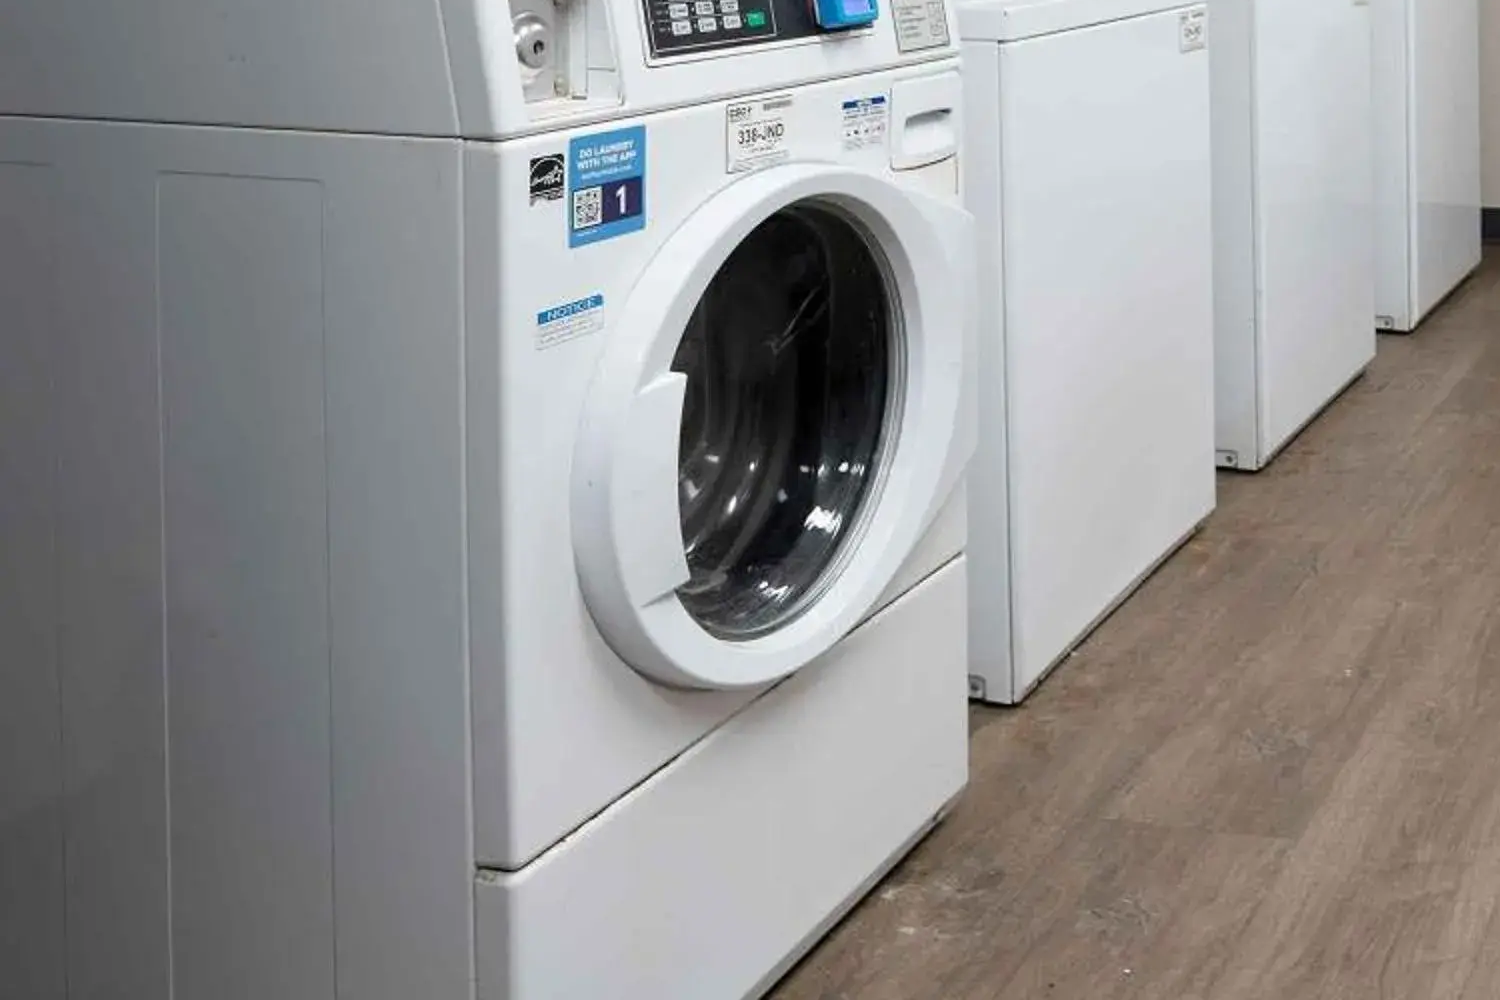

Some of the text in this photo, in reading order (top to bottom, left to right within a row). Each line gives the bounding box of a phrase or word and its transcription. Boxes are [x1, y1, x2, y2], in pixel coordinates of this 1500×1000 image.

[577, 149, 638, 169] WITH THE APP
[578, 140, 634, 159] DO LAUNDRY
[615, 184, 627, 214] 1
[547, 298, 595, 320] NOTICE
